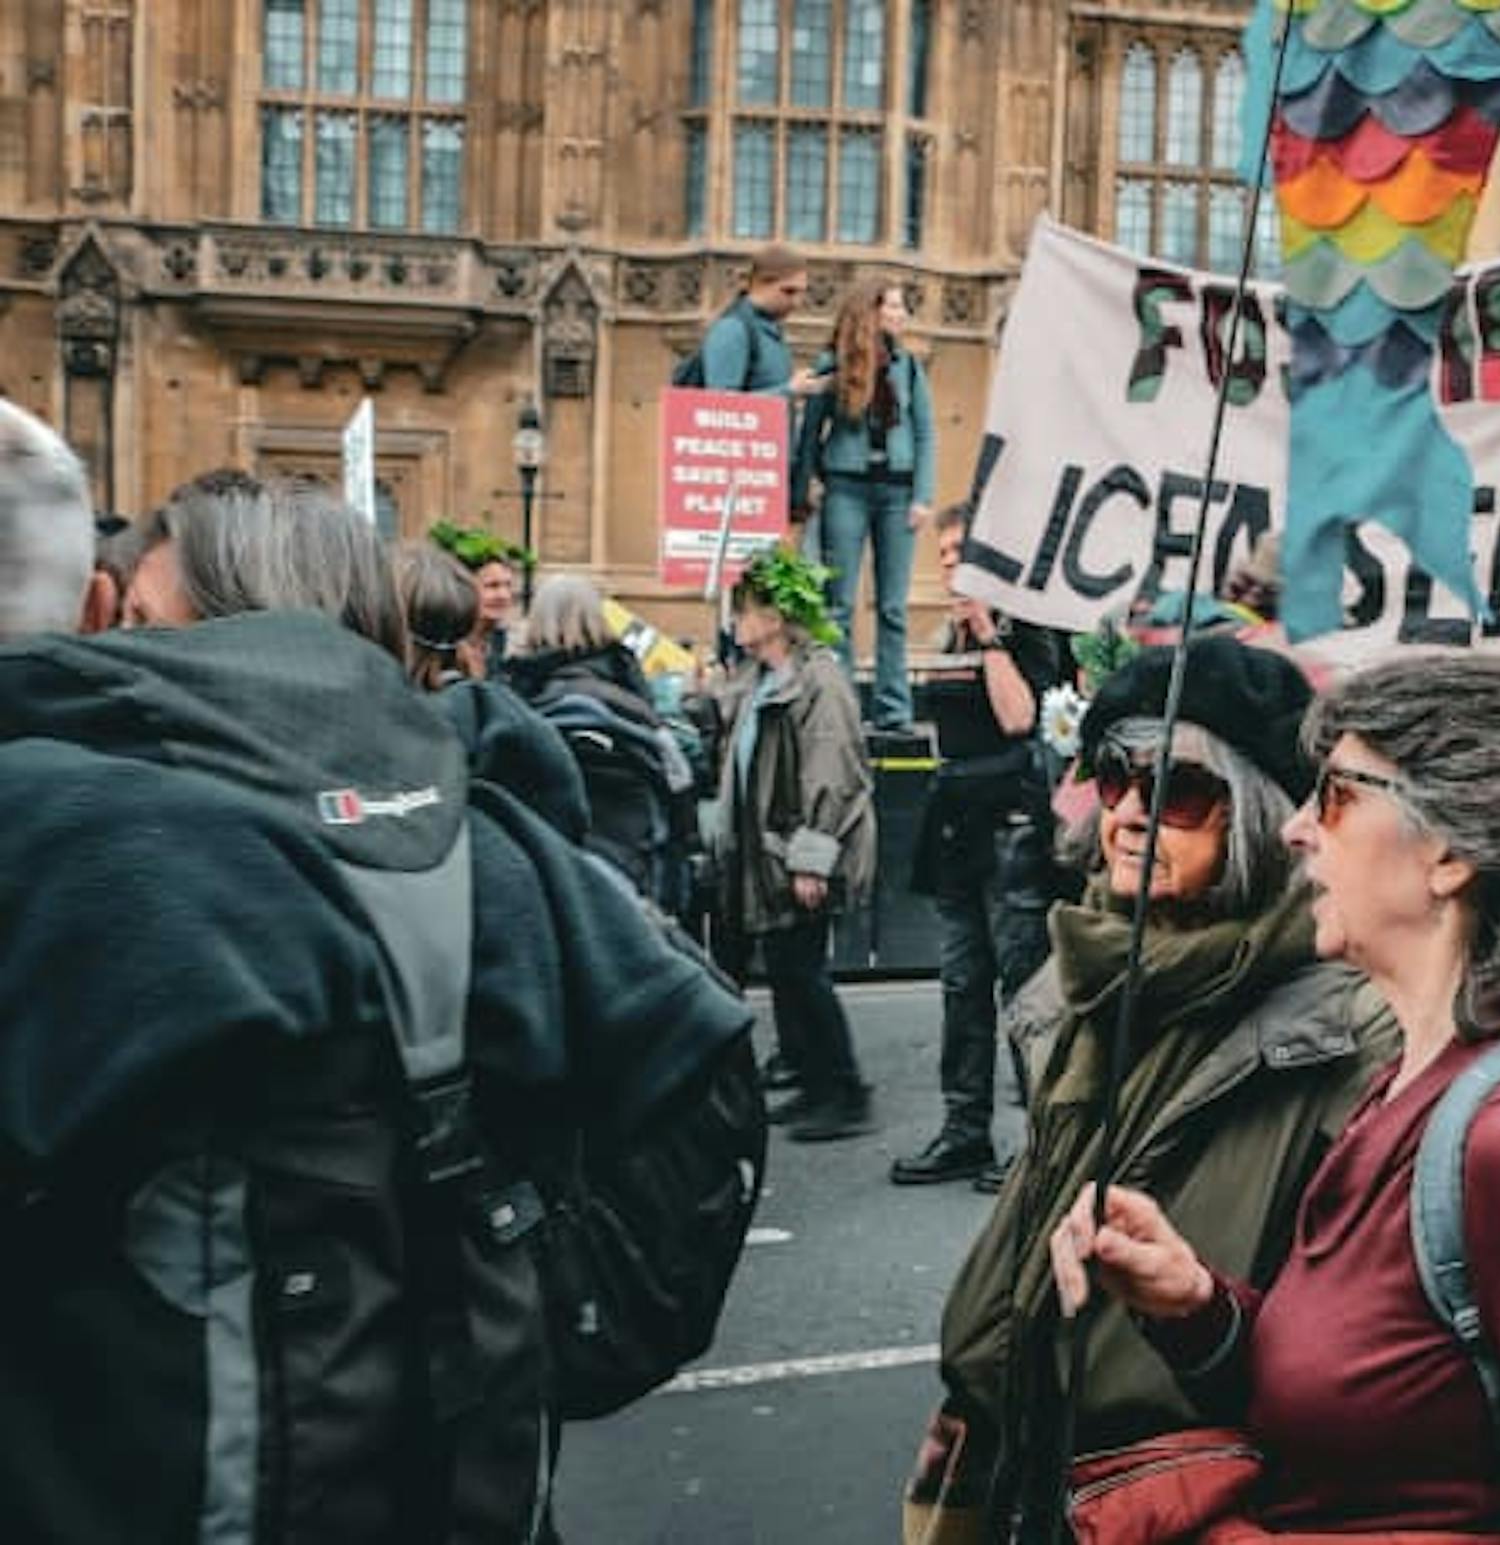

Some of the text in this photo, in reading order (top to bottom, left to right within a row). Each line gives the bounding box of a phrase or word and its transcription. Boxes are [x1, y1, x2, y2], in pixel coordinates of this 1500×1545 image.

[694, 409, 759, 430] BUILD
[673, 436, 778, 459] PEACE TO
[671, 465, 779, 487] SAVE OUR
